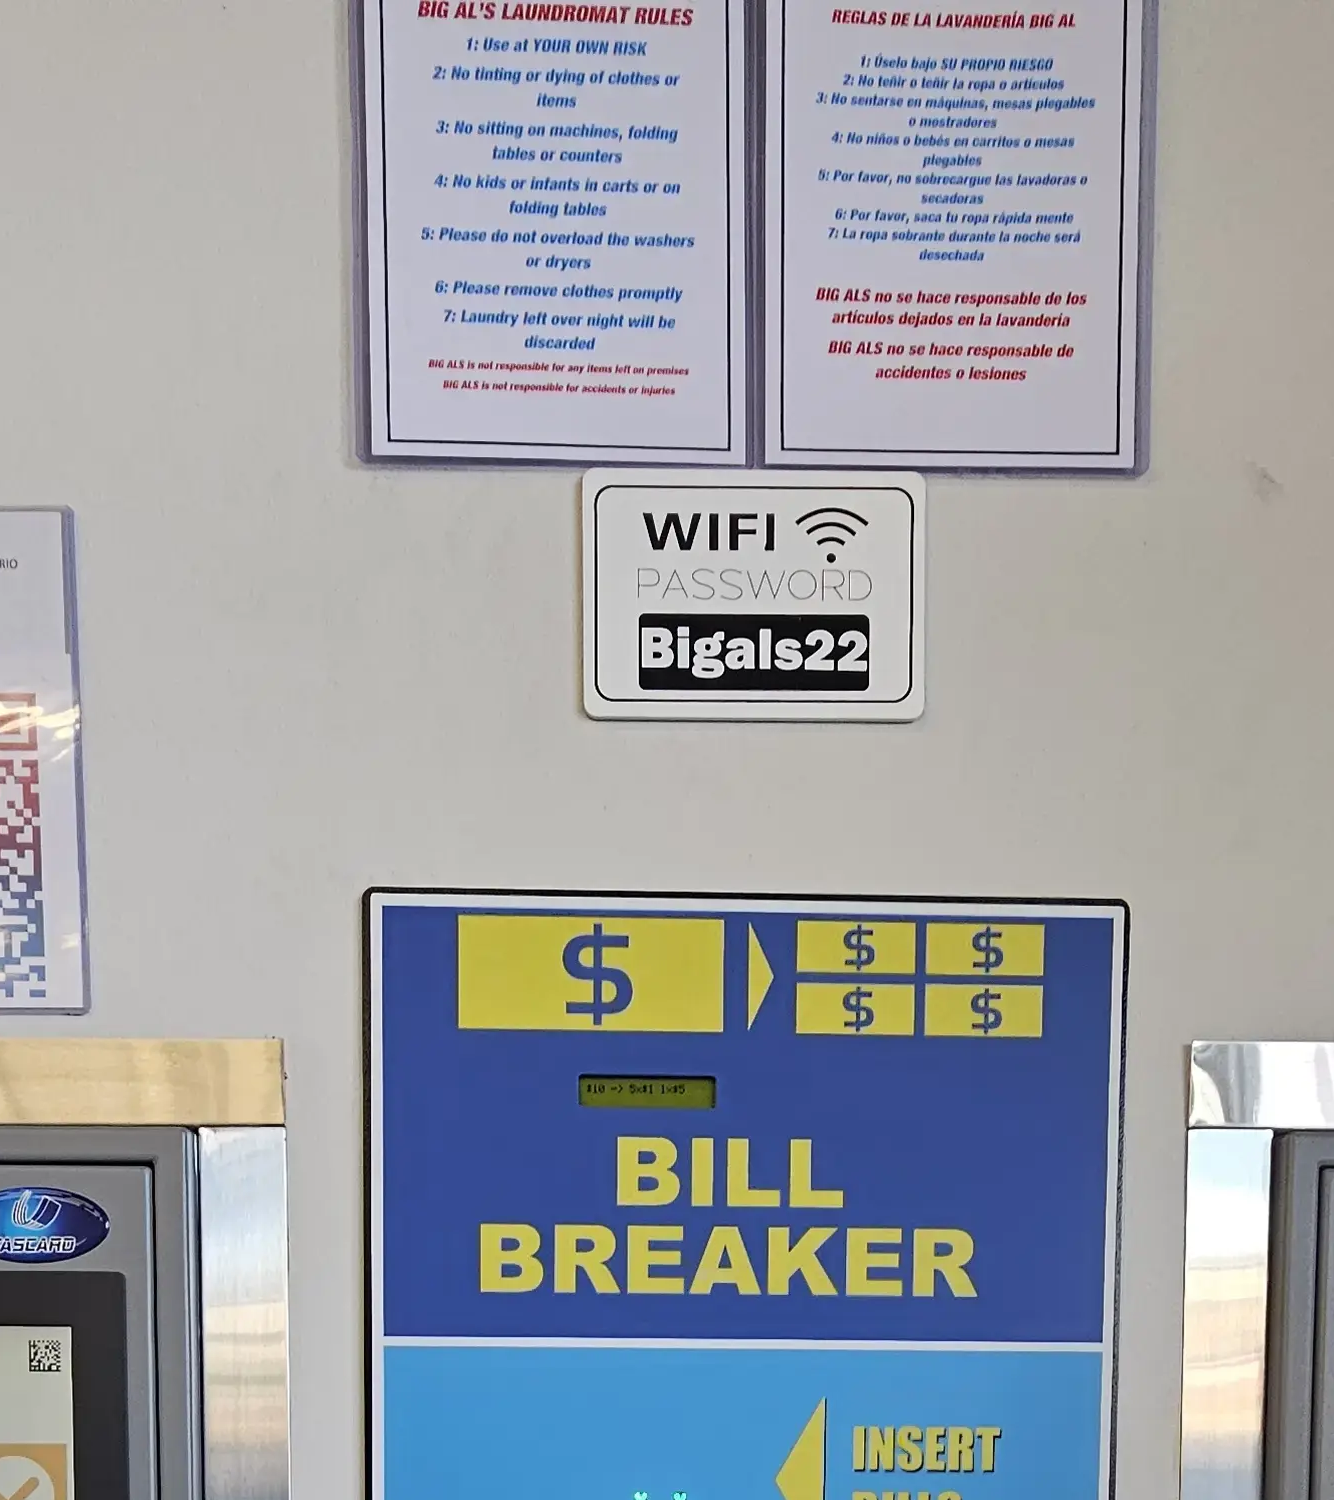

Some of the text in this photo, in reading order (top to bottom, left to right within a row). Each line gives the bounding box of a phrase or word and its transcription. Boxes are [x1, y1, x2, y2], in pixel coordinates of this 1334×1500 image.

[417, 0, 693, 26] BIG AL'S LAUNDROMAT RULES
[831, 9, 1075, 29] REGLAS DE LA LAVANDERÍA BIG AL
[467, 37, 647, 56] 1: Use at YOUR OWN RISK
[434, 280, 683, 303] 6: Please remove clothes promptly
[875, 365, 1026, 381] accidentes o lesiones
[642, 512, 775, 551] WIFI
[637, 567, 873, 601] PASSWORD
[641, 625, 868, 679] Bigals22
[561, 923, 634, 1026] $
[616, 1136, 844, 1208] BILL
[479, 1223, 978, 1297] BREAKER
[852, 1425, 1000, 1471] INSERT
